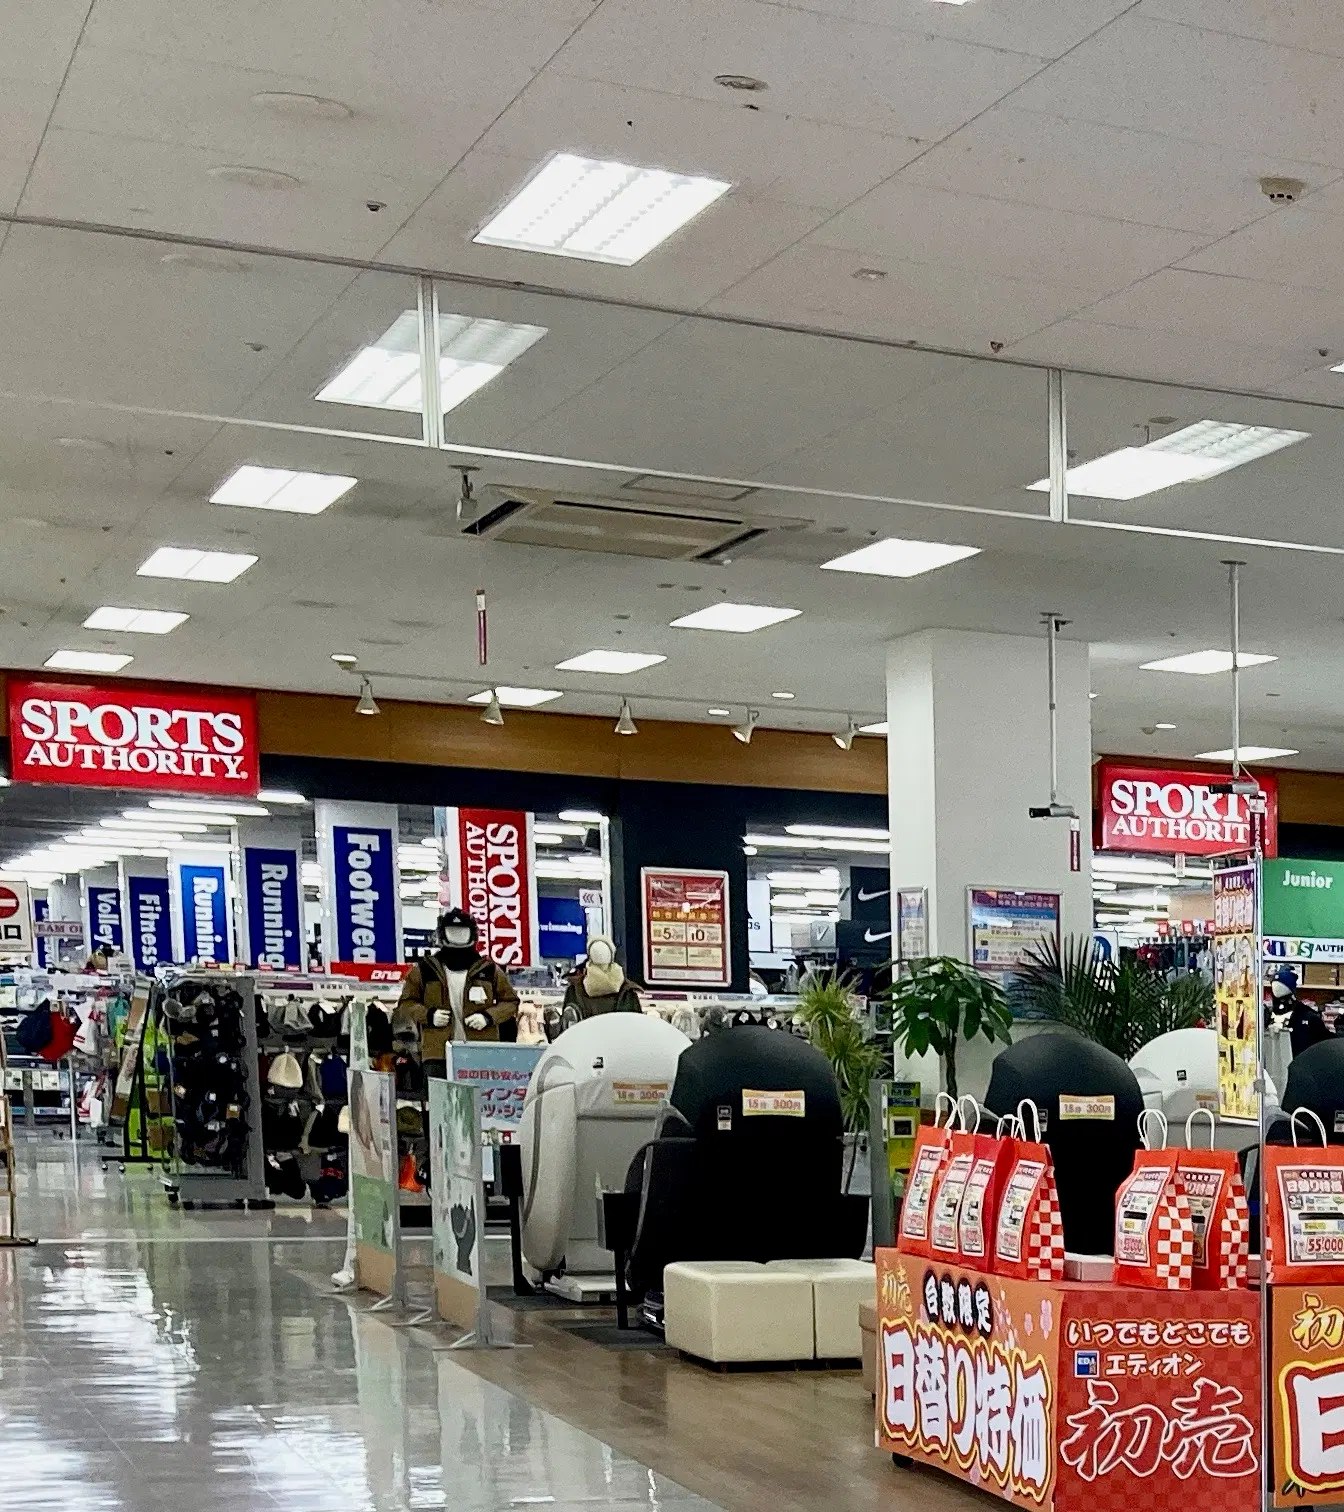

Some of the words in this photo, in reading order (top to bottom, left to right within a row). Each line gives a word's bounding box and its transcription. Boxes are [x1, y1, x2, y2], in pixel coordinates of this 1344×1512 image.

[21, 698, 245, 754] SPORTS
[1112, 816, 1252, 846] AUTHORIT
[486, 822, 524, 967] SPORTS
[1282, 869, 1333, 890] Junior
[138, 893, 163, 967] Fitness
[258, 863, 293, 970] Running
[923, 1273, 993, 1335] 台数限定
[1066, 1319, 1253, 1346] いつでもどこでも
[1106, 1352, 1205, 1378] エディオン
[883, 1326, 1049, 1488] 日替り特価
[1061, 1378, 1259, 1482] 初売
